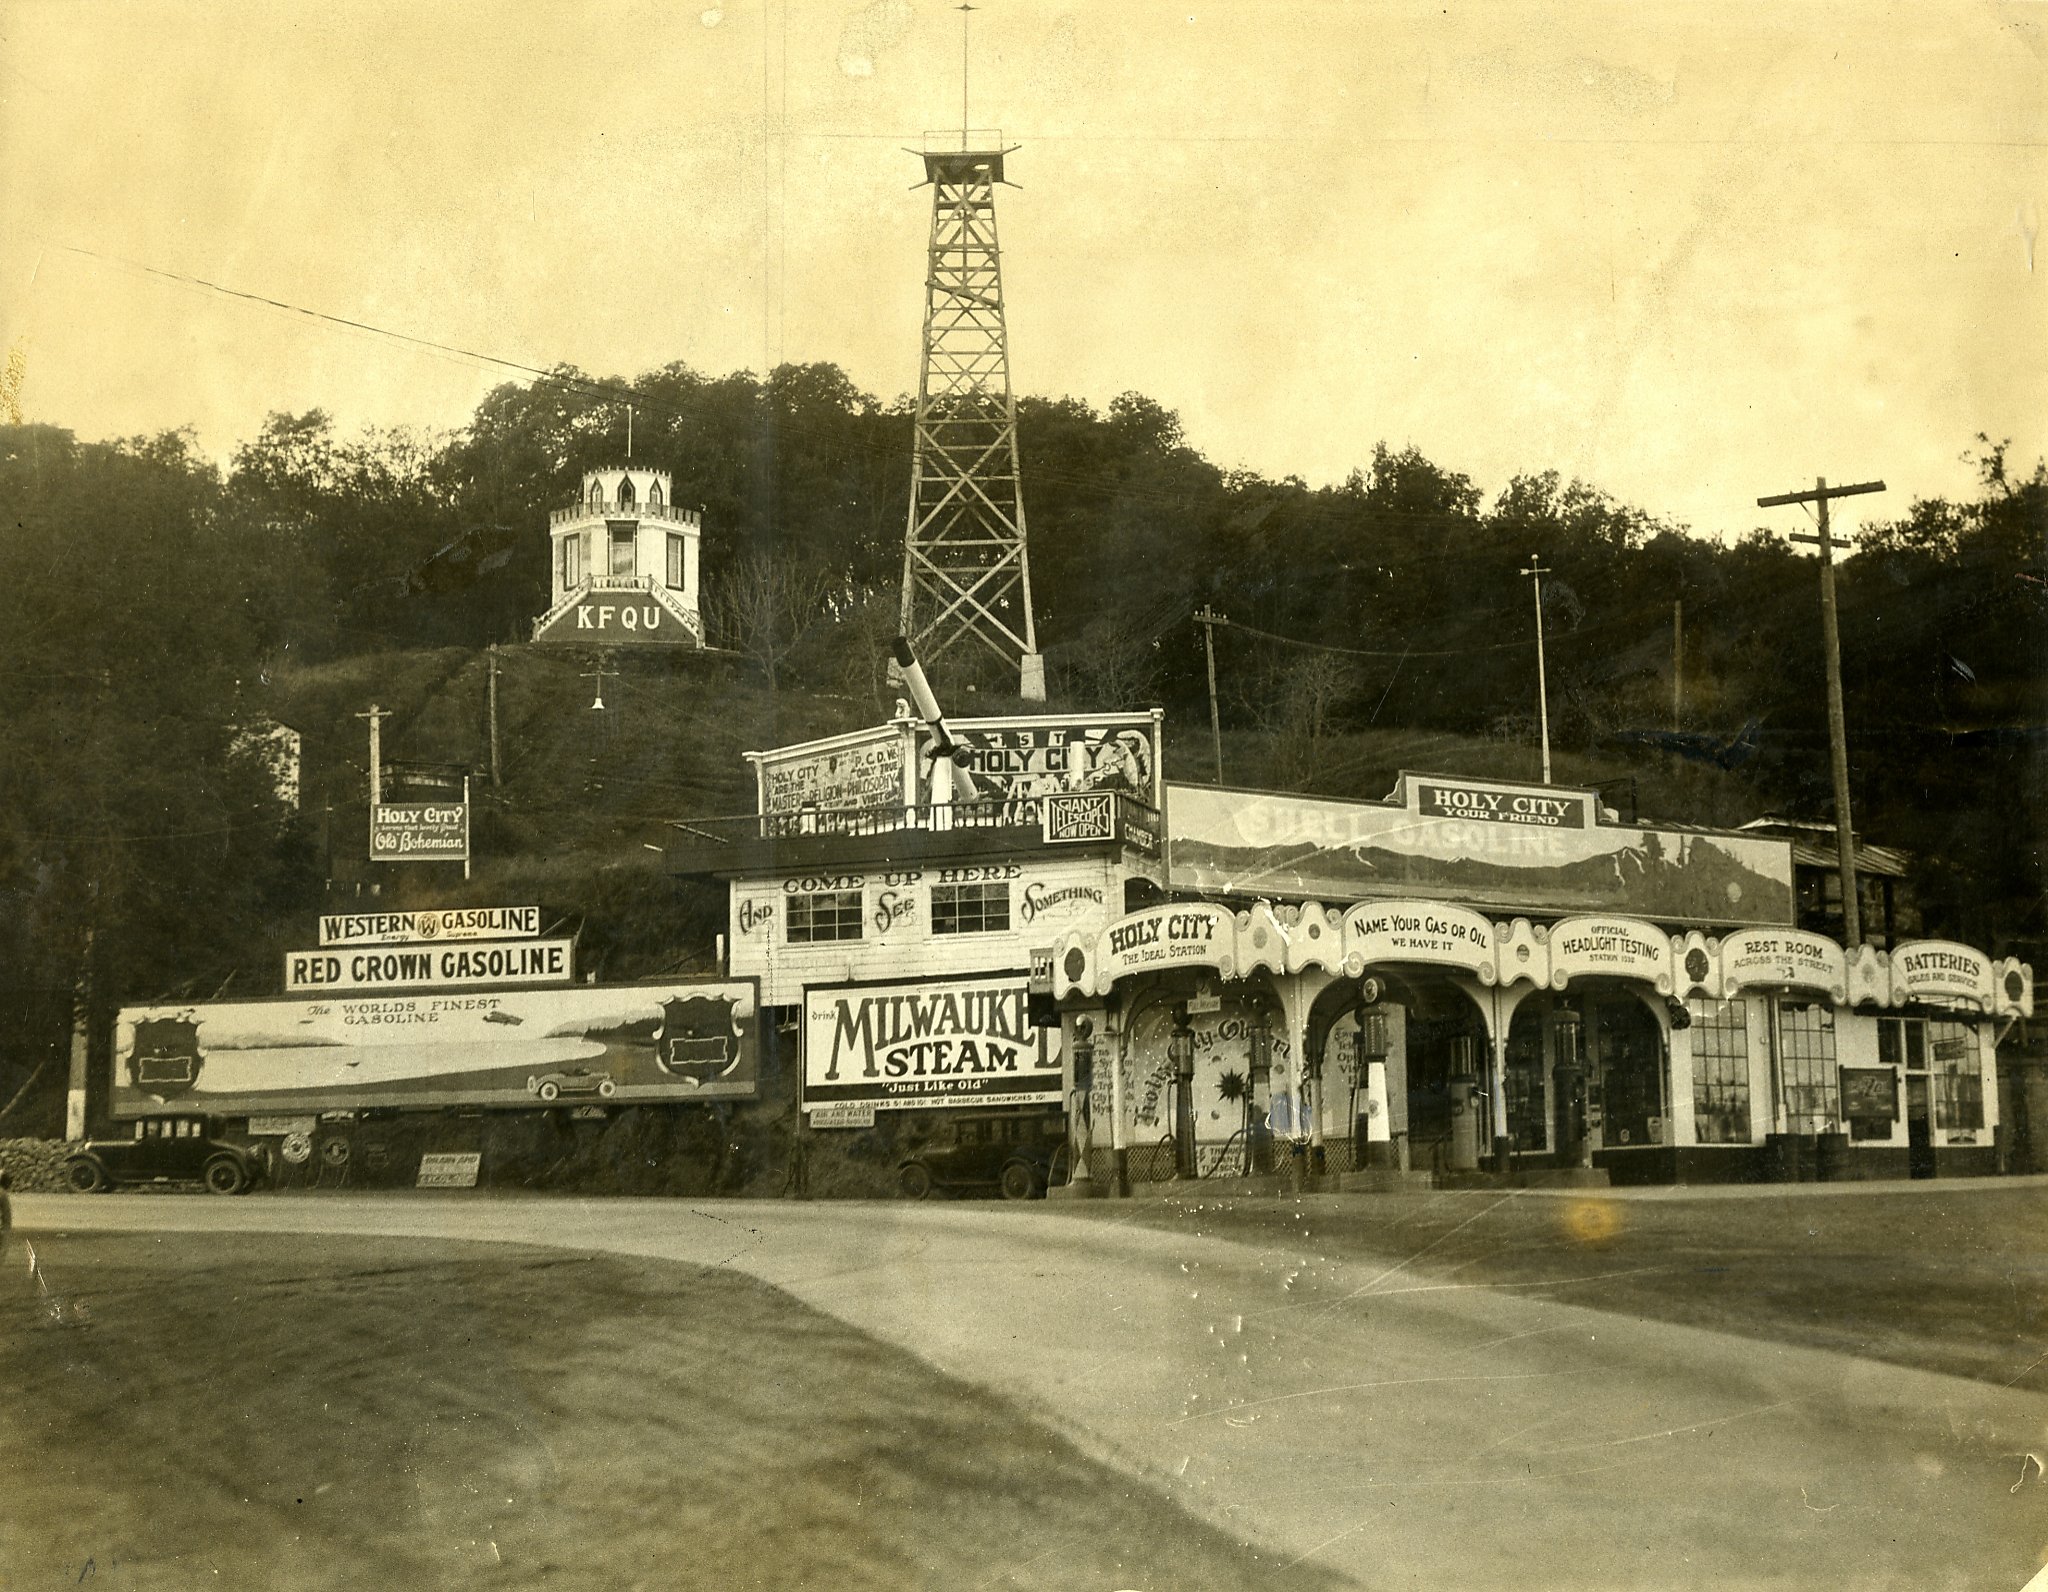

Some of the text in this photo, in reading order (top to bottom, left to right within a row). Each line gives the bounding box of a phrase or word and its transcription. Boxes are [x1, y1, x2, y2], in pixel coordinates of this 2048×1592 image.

[577, 605, 661, 631] KFQU
[857, 761, 898, 778] ONLY TRUE
[1045, 747, 1103, 771] CIY
[772, 764, 819, 784] HOLY CITY
[1059, 798, 1101, 812] GIANT
[1434, 790, 1571, 816] HOLY CITY
[377, 806, 463, 823] HOLY CITY
[1051, 797, 1109, 836] TELESCOPES
[1443, 807, 1559, 825] YOUR FRIEND
[1060, 823, 1100, 838] NOW OPEN
[1392, 818, 1567, 857] GASOLINE
[375, 831, 464, 853] Old Bohemian
[783, 865, 1023, 893] COME UP HERE
[740, 883, 1103, 935] AND SEE SOMETHING
[324, 914, 416, 941] WESTERN
[441, 908, 537, 933] GASOLINE
[1109, 914, 1219, 955] HOLY CITY
[1354, 915, 1487, 949] NAME YOUR GAS OR OIL
[1591, 926, 1629, 937] OFFICIAL
[1392, 937, 1453, 950] WE HAVE IT
[1563, 937, 1659, 961] HEADLIGHT TESTING
[1745, 940, 1823, 959] REST ROOM
[293, 946, 564, 985] RED CROWN GASOLINE
[1122, 945, 1207, 966] THE IDEAL STATION
[1589, 954, 1618, 962] STATION
[1734, 955, 1834, 973] ACROSS THE STREET
[1904, 952, 1980, 977] BATTERIES
[307, 999, 500, 1016] The WORLDS FINEST
[344, 1012, 439, 1025] GASOLINE
[884, 1040, 1018, 1077] STEAM
[924, 1080, 954, 1092] Like
[848, 1109, 871, 1117] WATER
